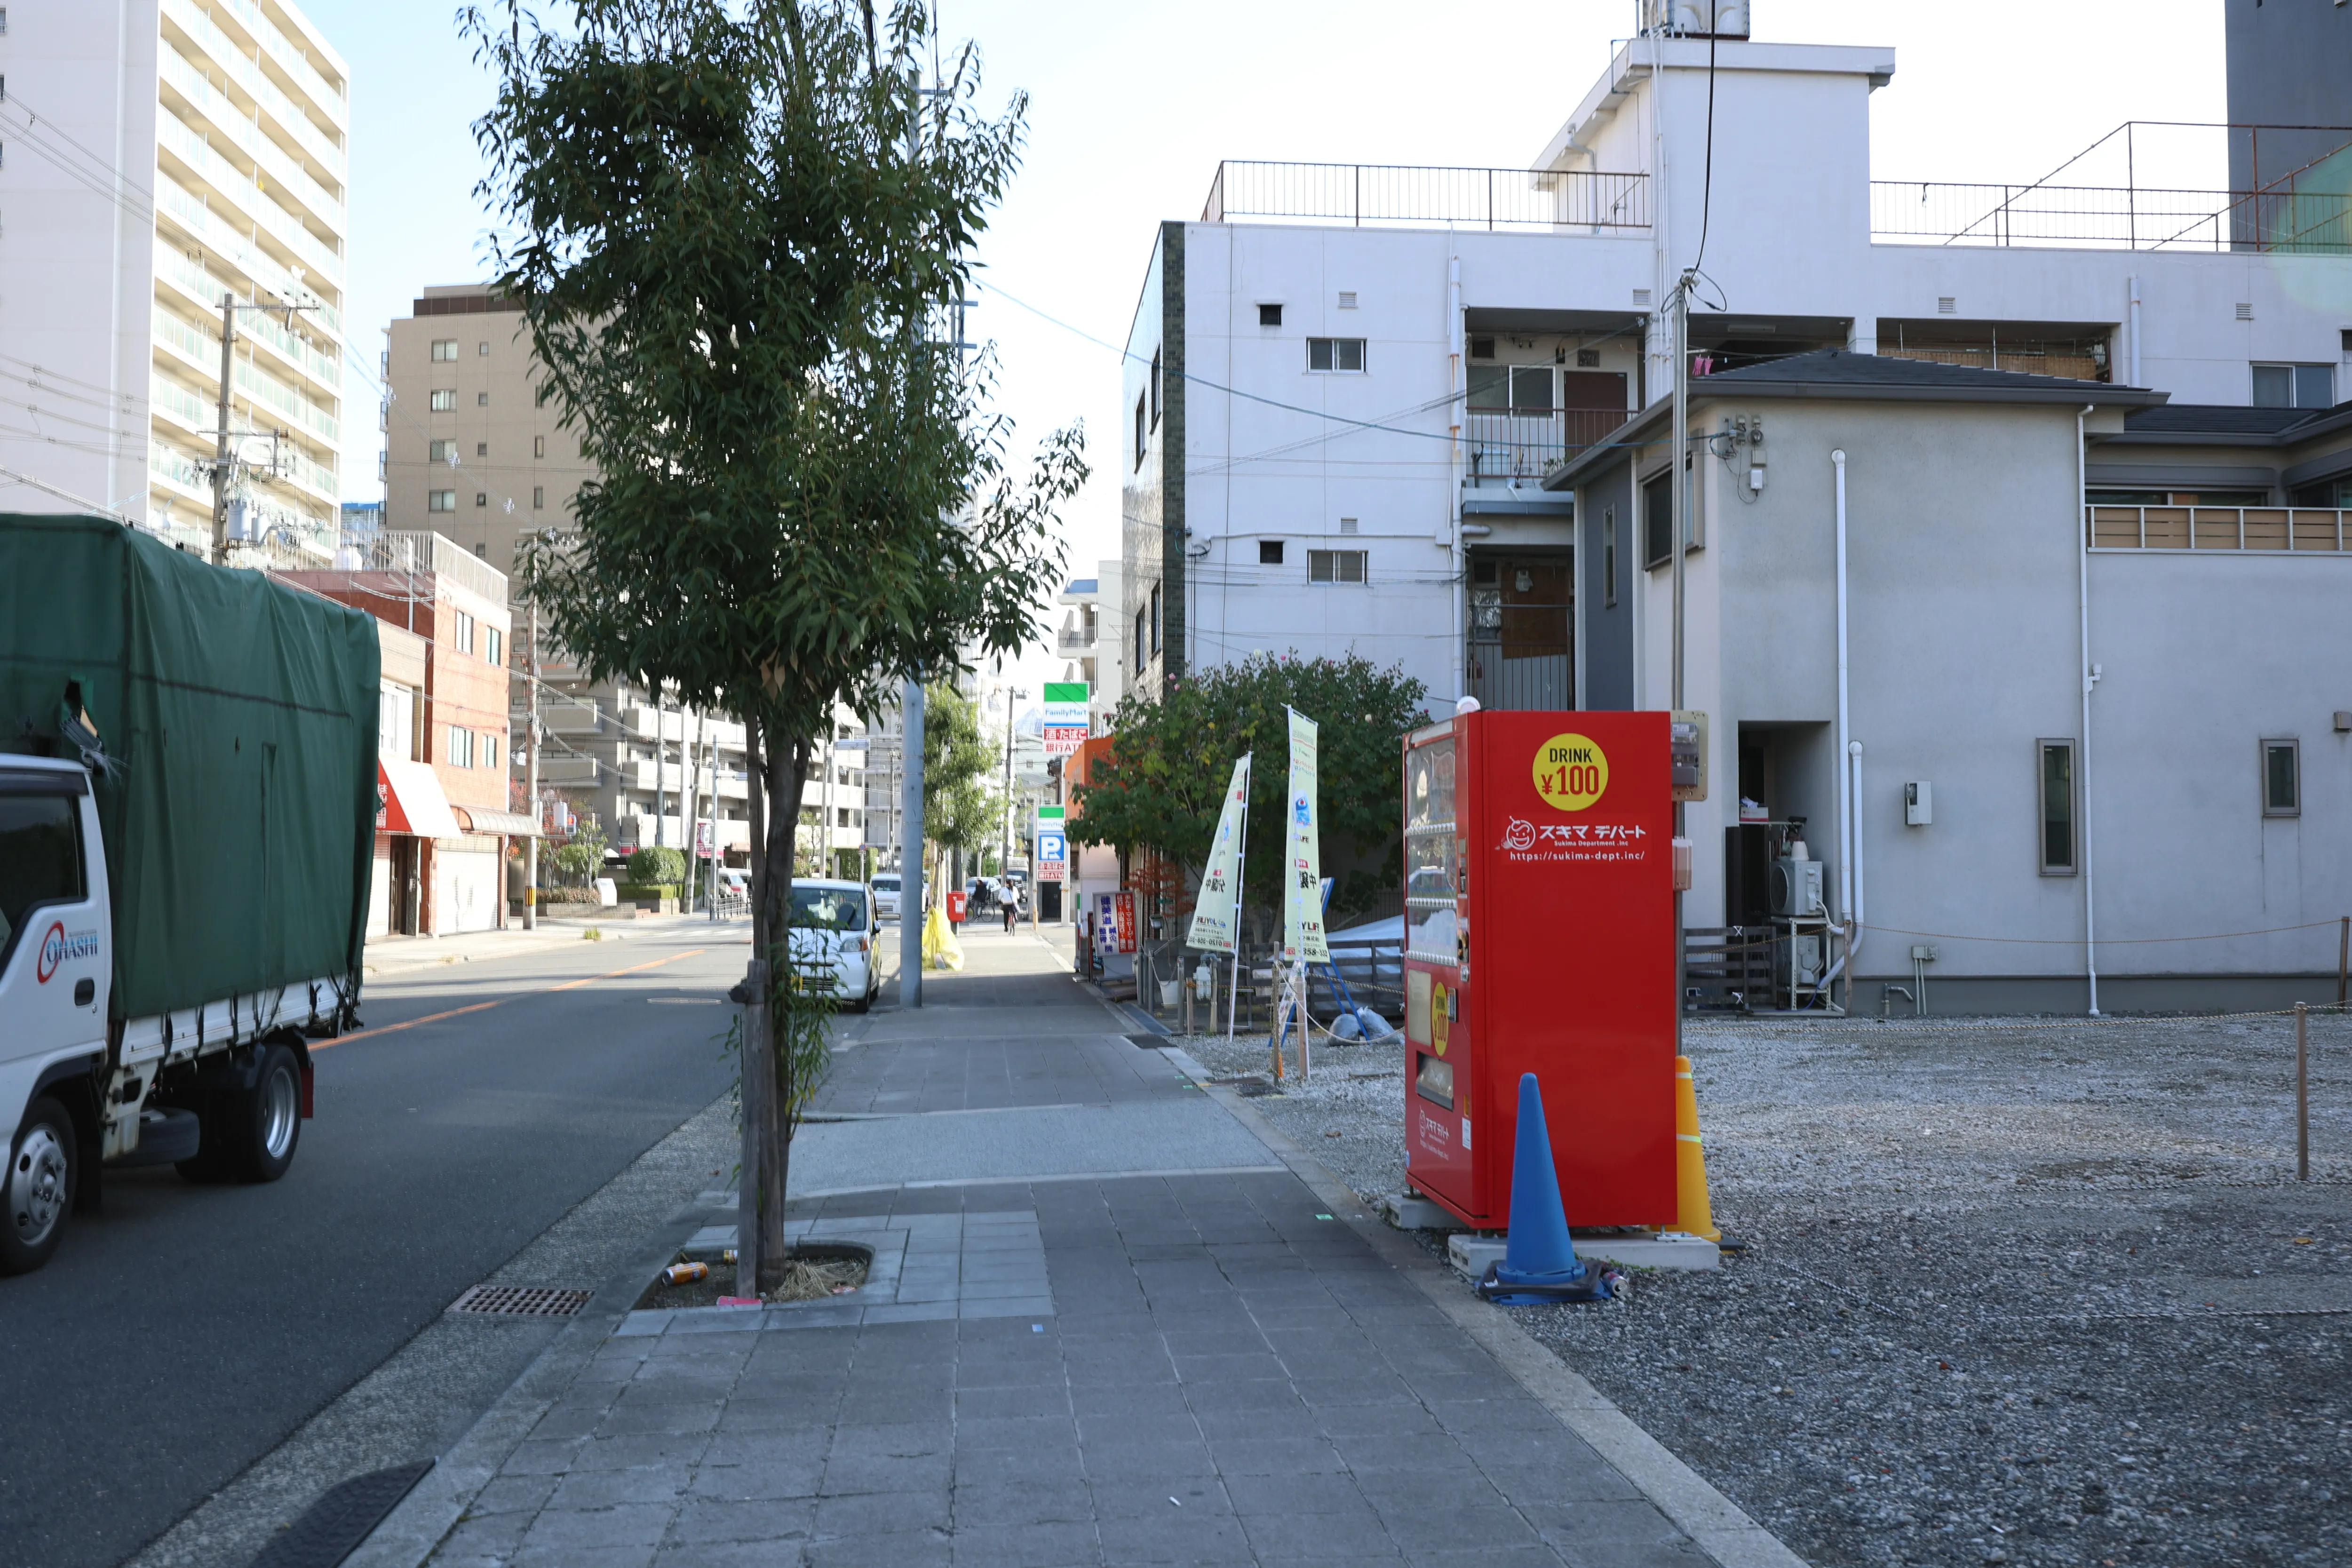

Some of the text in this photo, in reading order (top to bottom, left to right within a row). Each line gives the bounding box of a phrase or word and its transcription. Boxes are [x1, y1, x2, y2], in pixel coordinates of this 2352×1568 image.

[1045, 708, 1087, 717] FamilyMart
[1046, 742, 1083, 753] 銀行AT
[1549, 748, 1592, 763] DRINK
[1541, 765, 1599, 795] ¥100
[1539, 825, 1646, 839] スキマ デパート
[1510, 851, 1645, 862] https://sukima-dept.inc/
[47, 936, 97, 963] OHASHI
